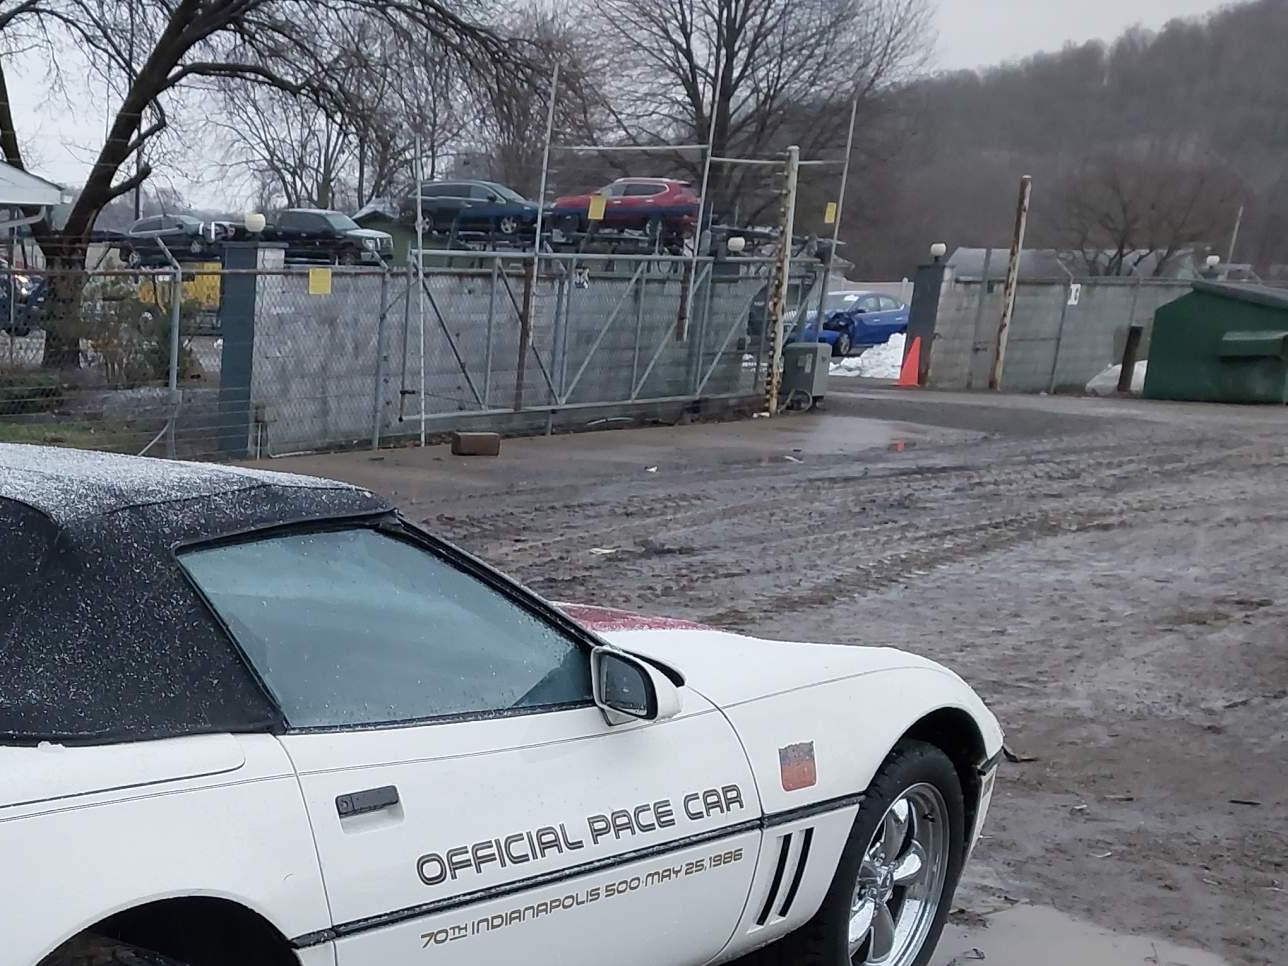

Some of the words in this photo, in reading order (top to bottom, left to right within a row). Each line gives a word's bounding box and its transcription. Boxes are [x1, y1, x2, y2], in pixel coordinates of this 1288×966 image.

[416, 823, 584, 886] OFFICIAL
[587, 799, 675, 844] PACE
[683, 784, 745, 819] CAR
[471, 886, 601, 935] INDIANAPOLIS
[604, 876, 641, 898] 500
